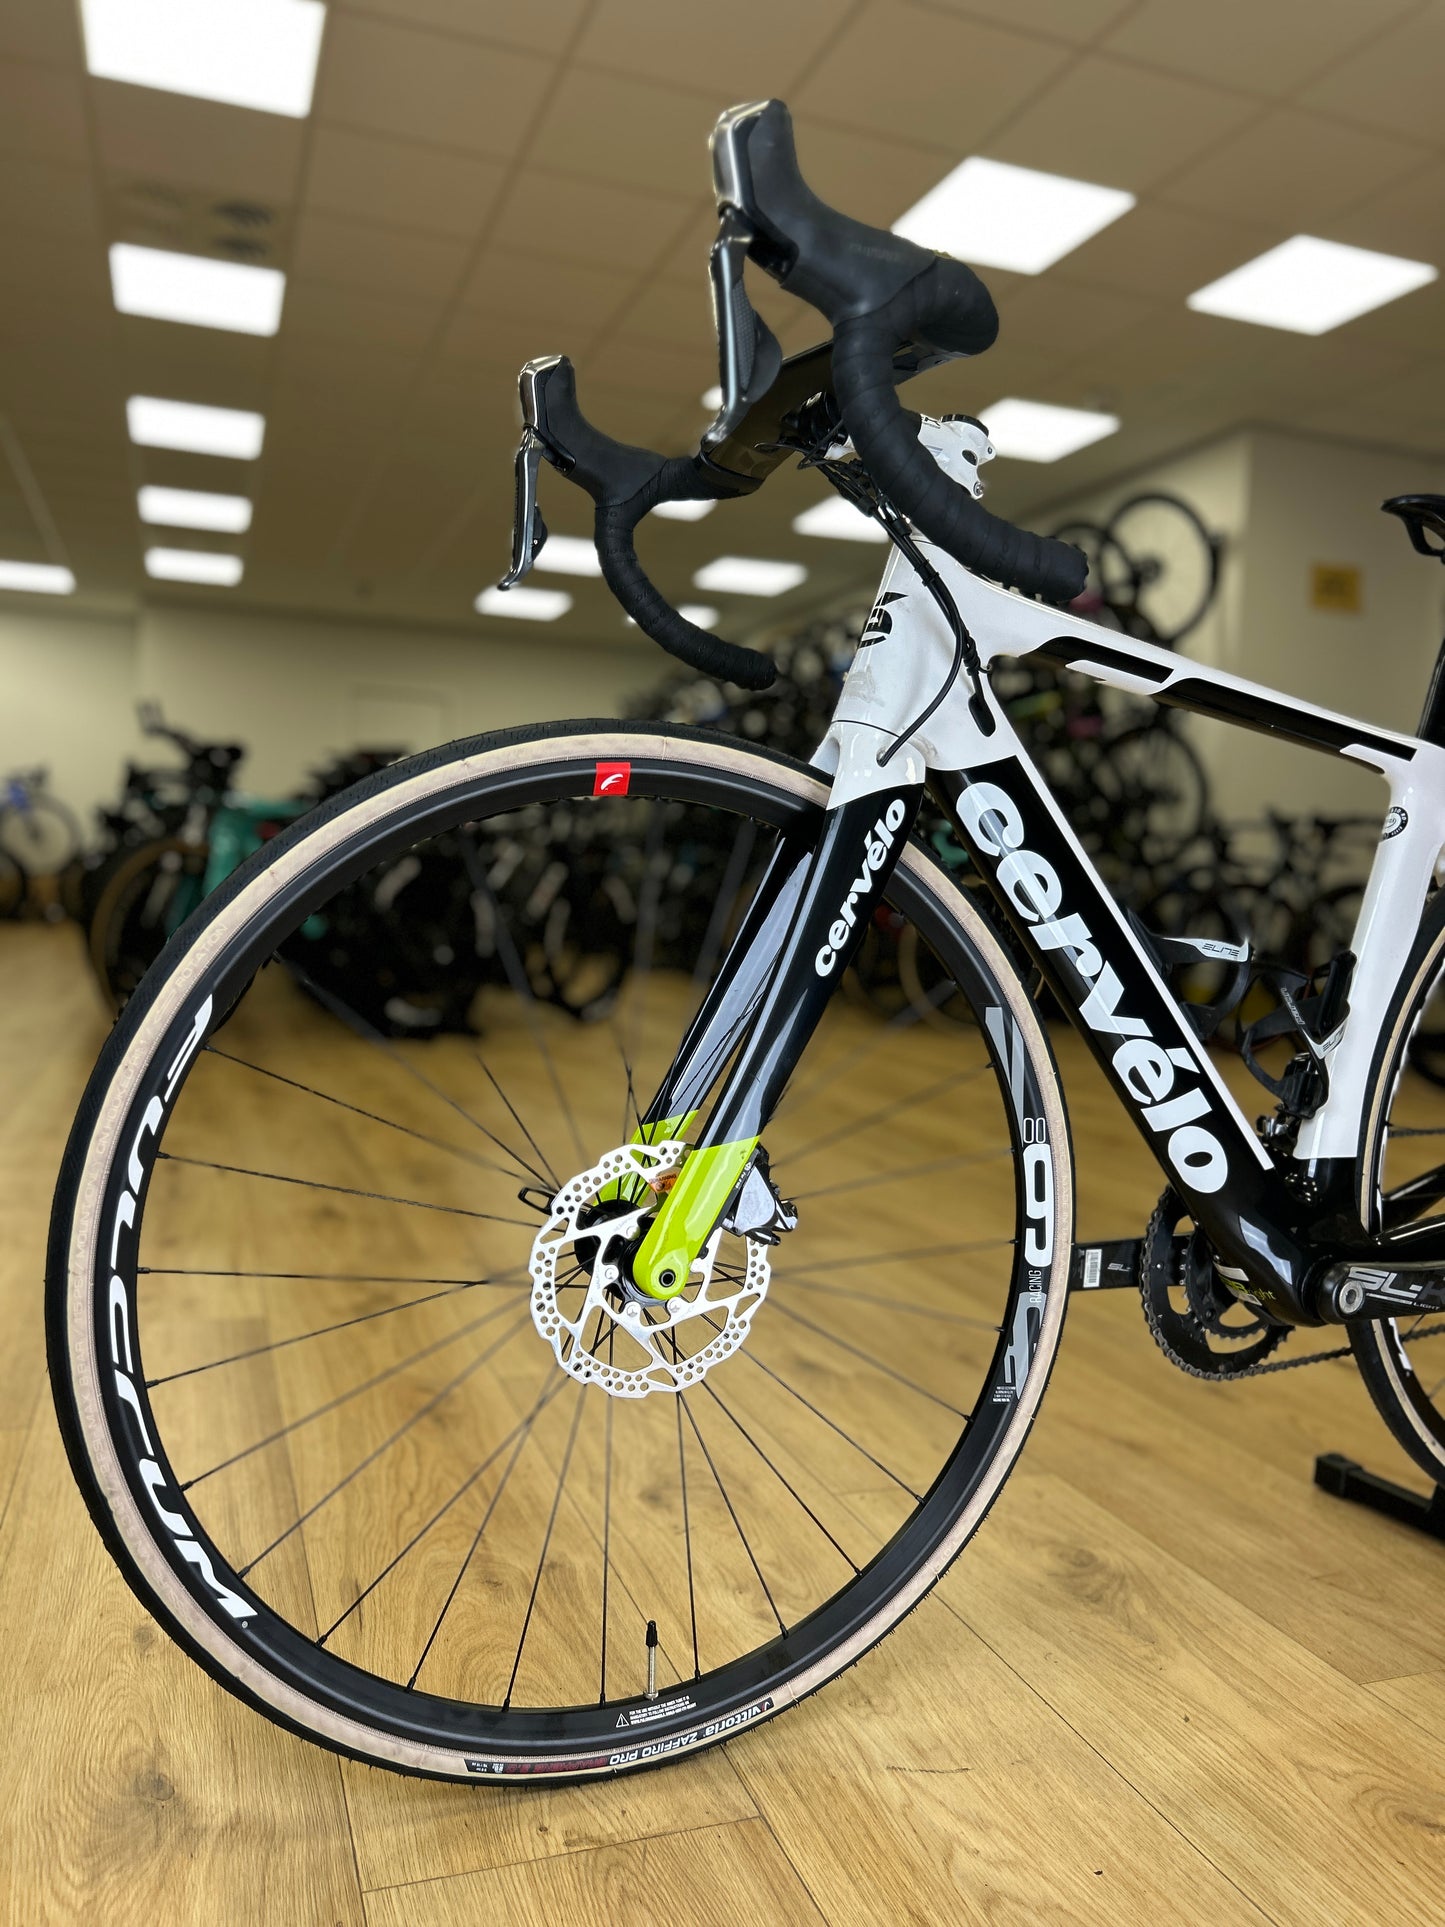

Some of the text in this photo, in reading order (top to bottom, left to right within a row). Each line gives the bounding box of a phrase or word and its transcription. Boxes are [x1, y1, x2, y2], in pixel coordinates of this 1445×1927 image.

[815, 798, 905, 978] cervélo
[173, 920, 228, 990] ROTATION
[1202, 942, 1240, 957] ELITE
[956, 781, 1230, 1195] cervélo
[1028, 1270, 1043, 1303] RACING
[1413, 1302, 1440, 1311] LIGHT
[609, 1748, 640, 1765] PRO
[643, 1732, 698, 1758] ZAFFIRO
